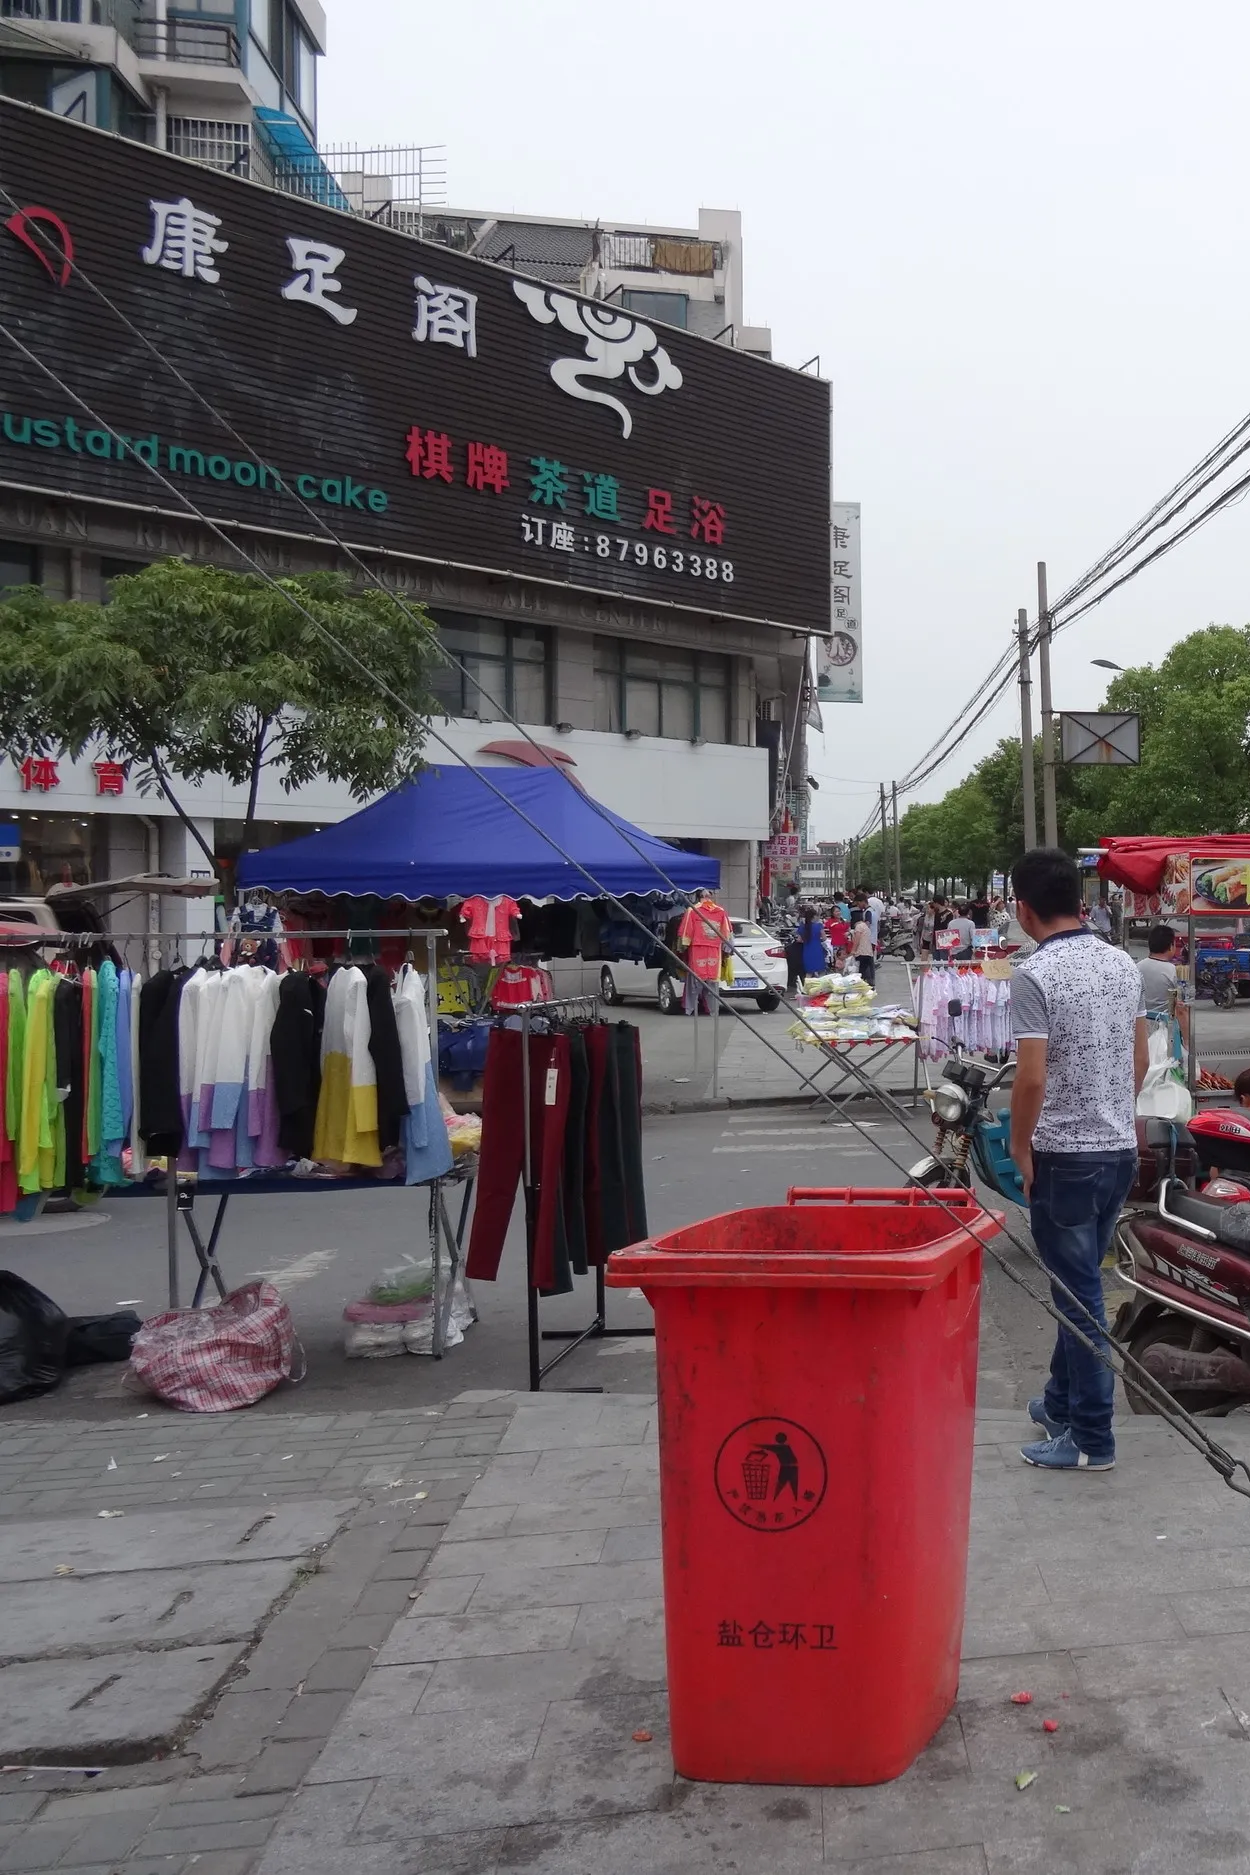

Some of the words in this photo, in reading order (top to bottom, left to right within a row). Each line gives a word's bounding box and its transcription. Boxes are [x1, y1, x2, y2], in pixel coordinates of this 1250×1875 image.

[142, 198, 478, 358] 康足阁
[3, 412, 159, 468] ustard
[168, 445, 282, 493] moon
[297, 473, 389, 513] cake
[405, 426, 510, 494] 棋牌
[528, 456, 621, 522] 茶道
[643, 488, 727, 545] 足浴
[0, 498, 88, 537] UAN
[19, 756, 125, 796] 体育
[717, 1619, 838, 1650] 盐仓环卫
